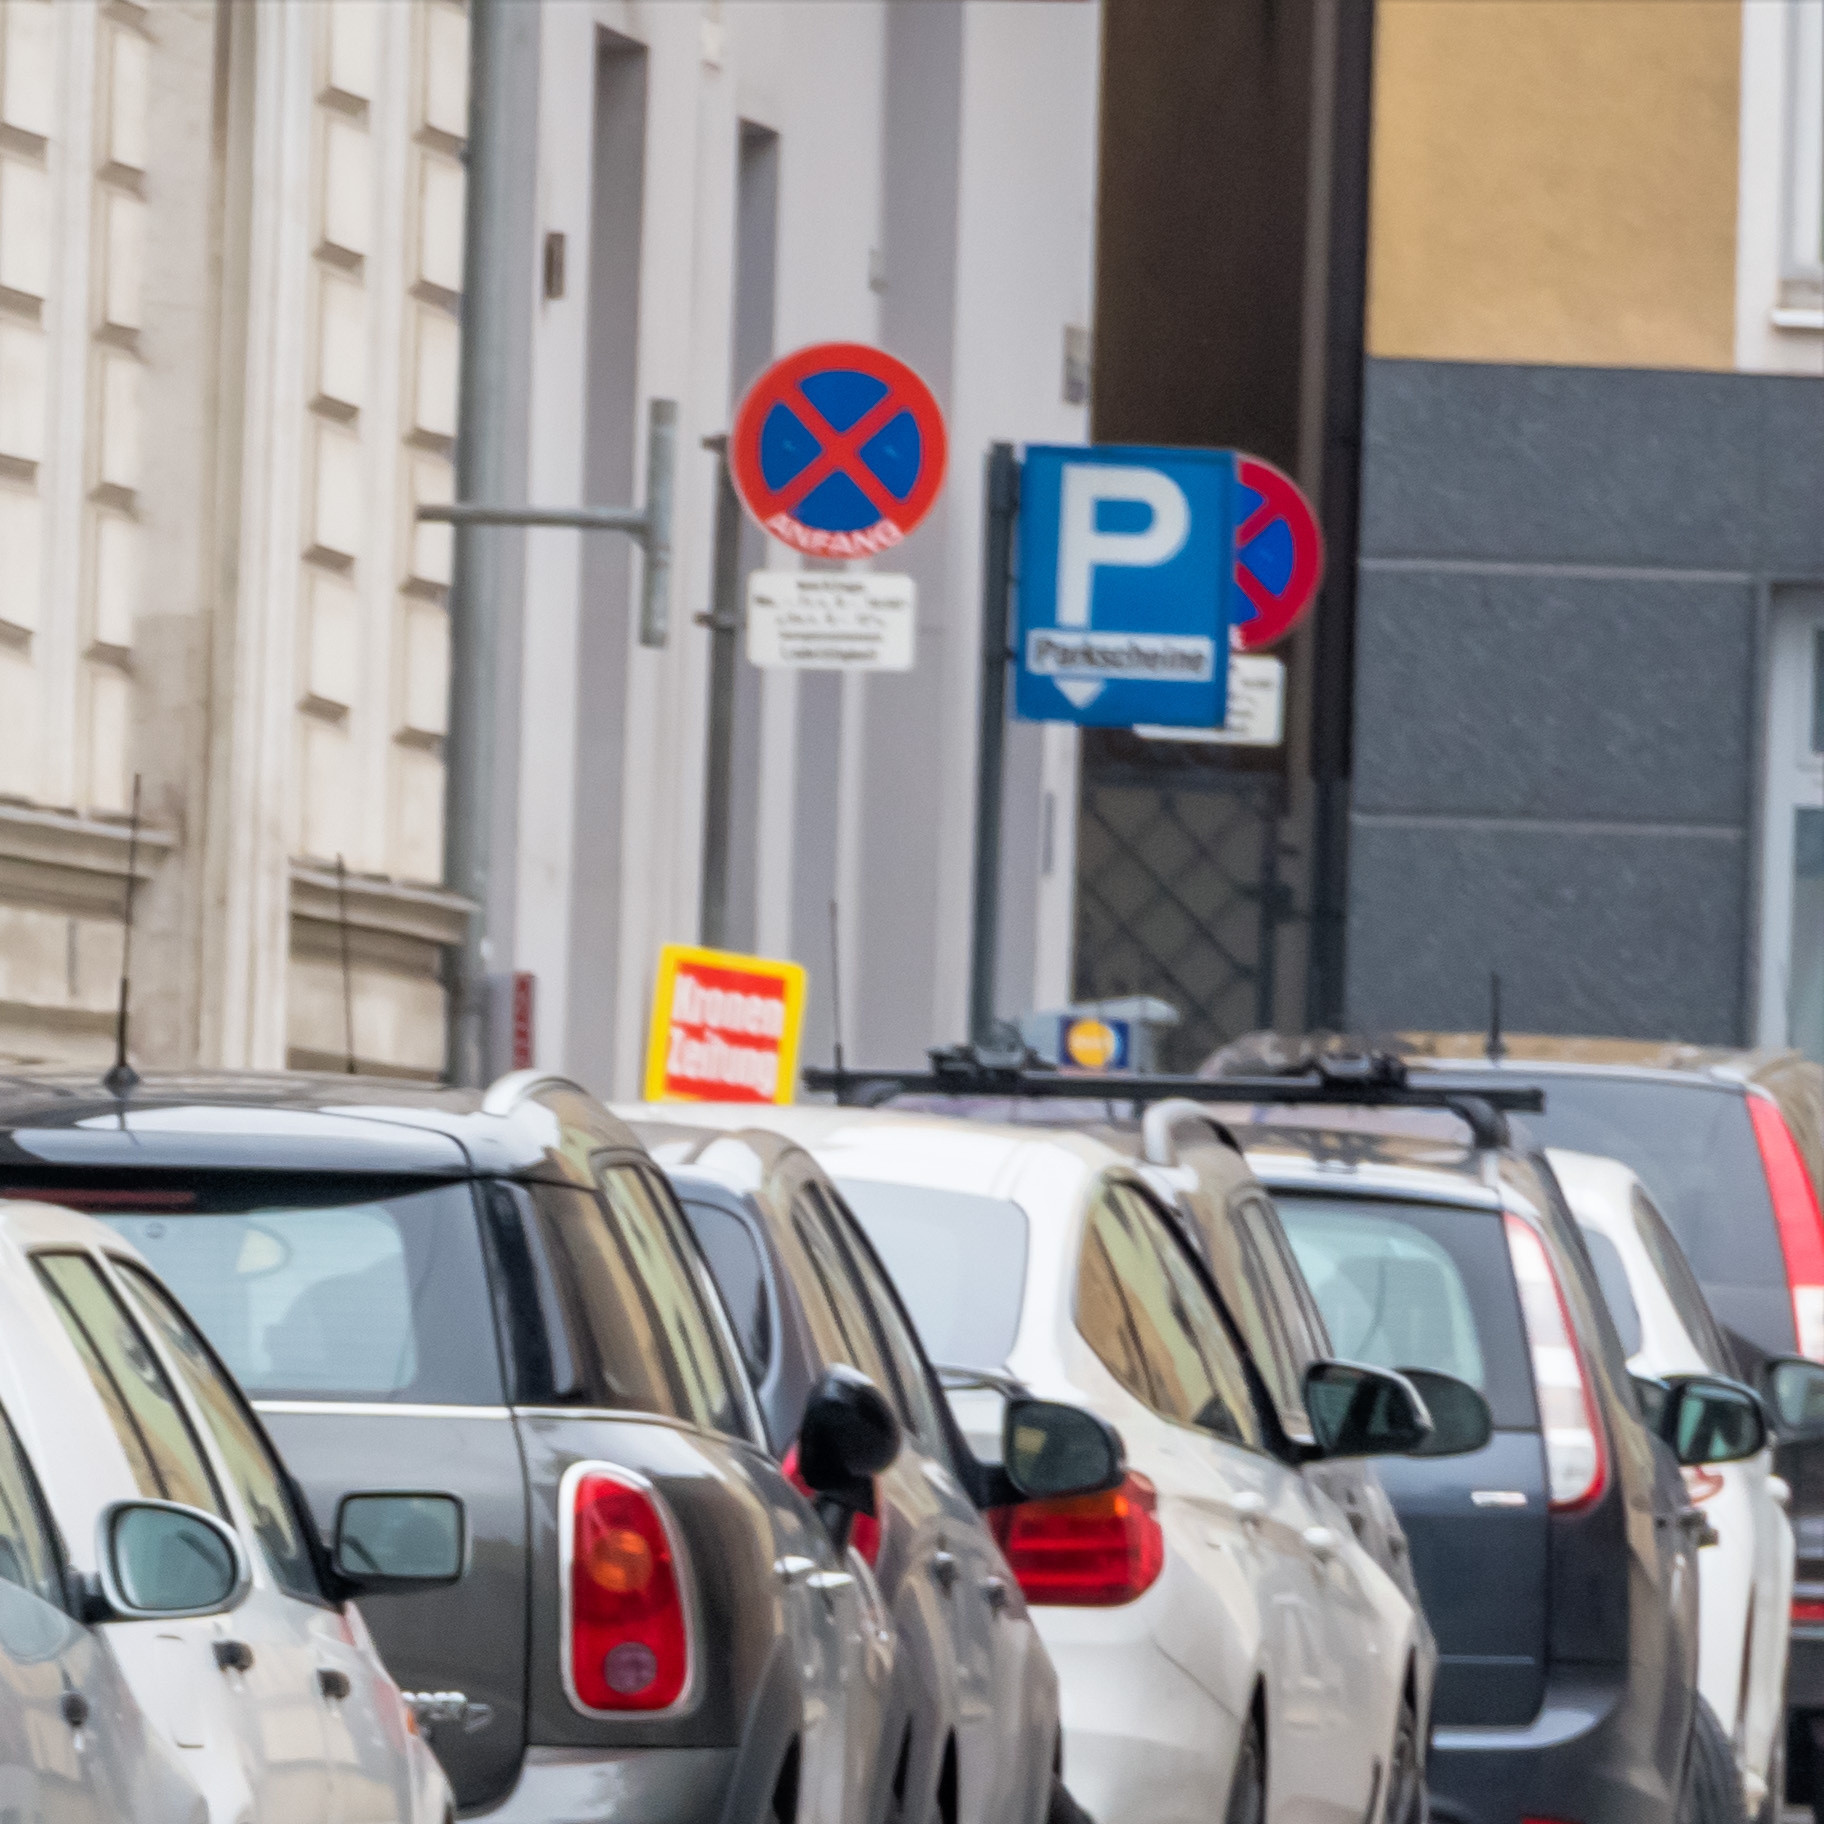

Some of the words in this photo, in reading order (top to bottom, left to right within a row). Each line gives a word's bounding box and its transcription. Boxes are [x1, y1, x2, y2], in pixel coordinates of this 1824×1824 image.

[1054, 463, 1192, 628] P
[672, 971, 786, 1038] Kronen
[666, 1025, 780, 1098] Zeitung
